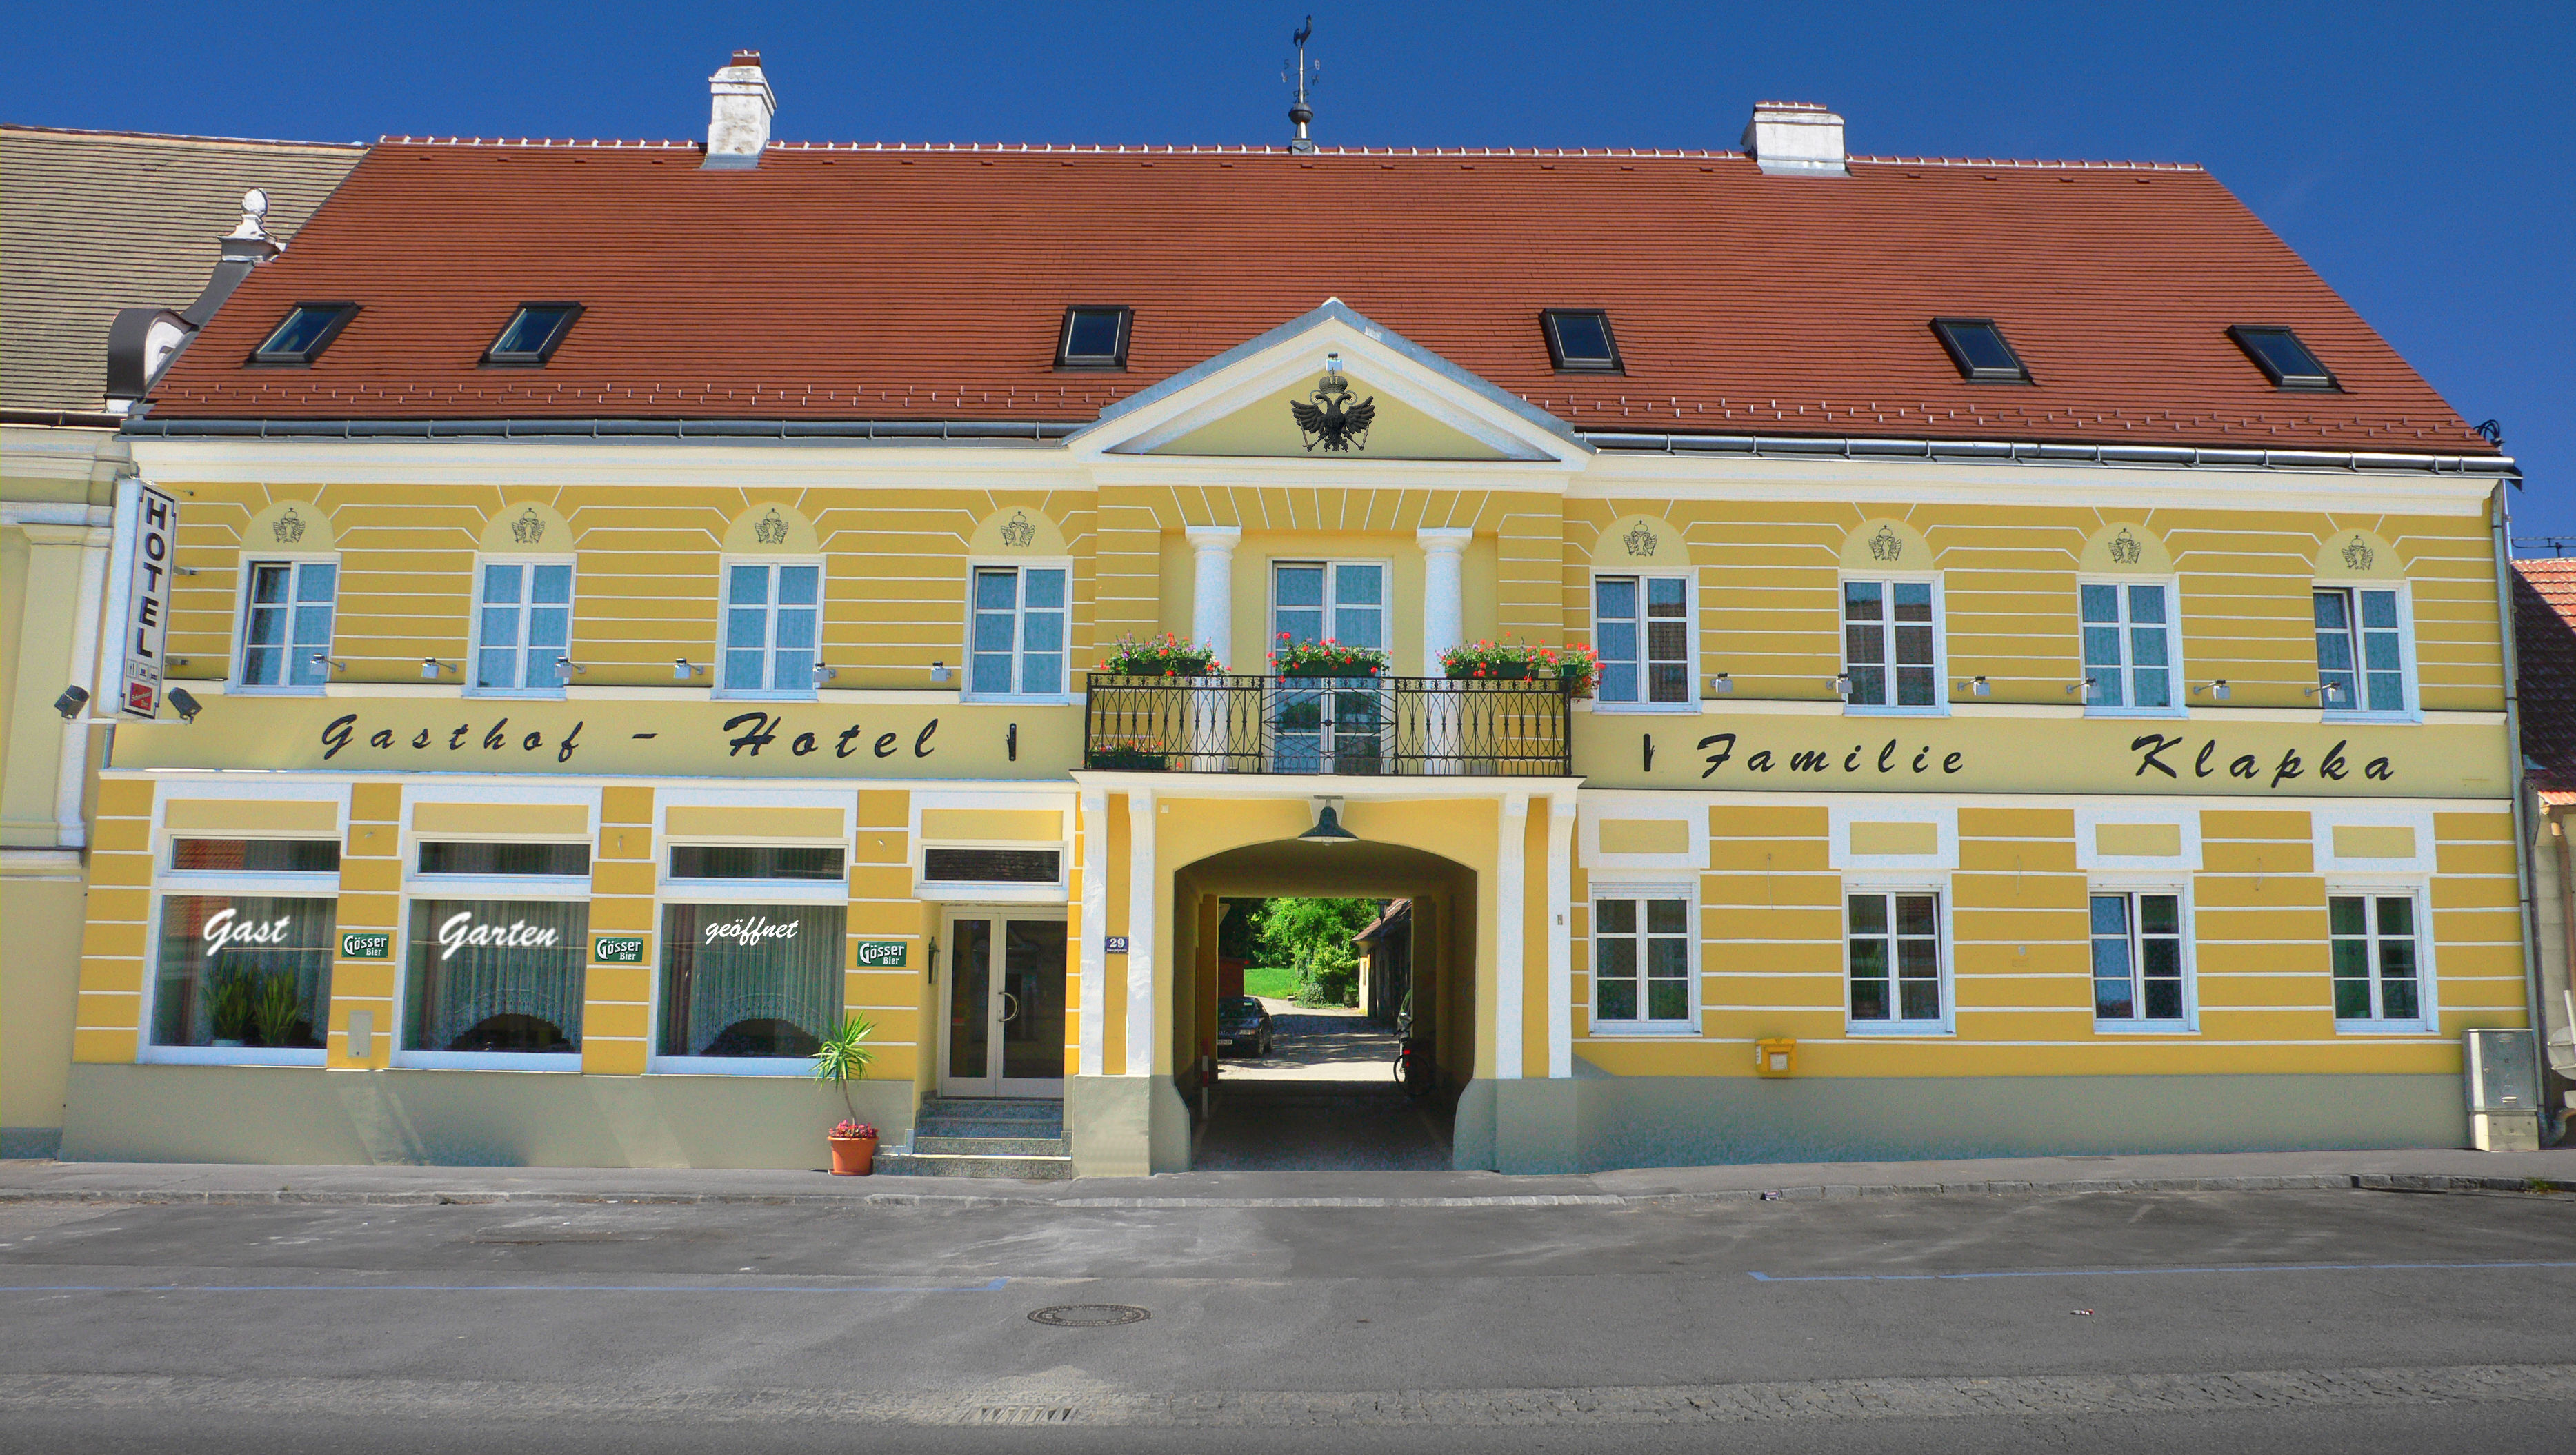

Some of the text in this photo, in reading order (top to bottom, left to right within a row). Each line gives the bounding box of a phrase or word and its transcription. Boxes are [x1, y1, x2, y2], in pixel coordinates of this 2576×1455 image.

[137, 497, 168, 658] HOTEL
[321, 713, 583, 763] Gasthof
[722, 711, 939, 759] Hotel
[1696, 732, 2395, 789] Familie Klapka
[203, 908, 799, 960] Gast Garten geöffnet
[1110, 938, 1125, 948] 29
[343, 935, 387, 956] Gösser
[366, 947, 382, 956] Bier
[597, 938, 641, 960] Gösser
[619, 951, 636, 960] Bier
[859, 942, 905, 964] Gösser
[883, 956, 899, 964] Bier
